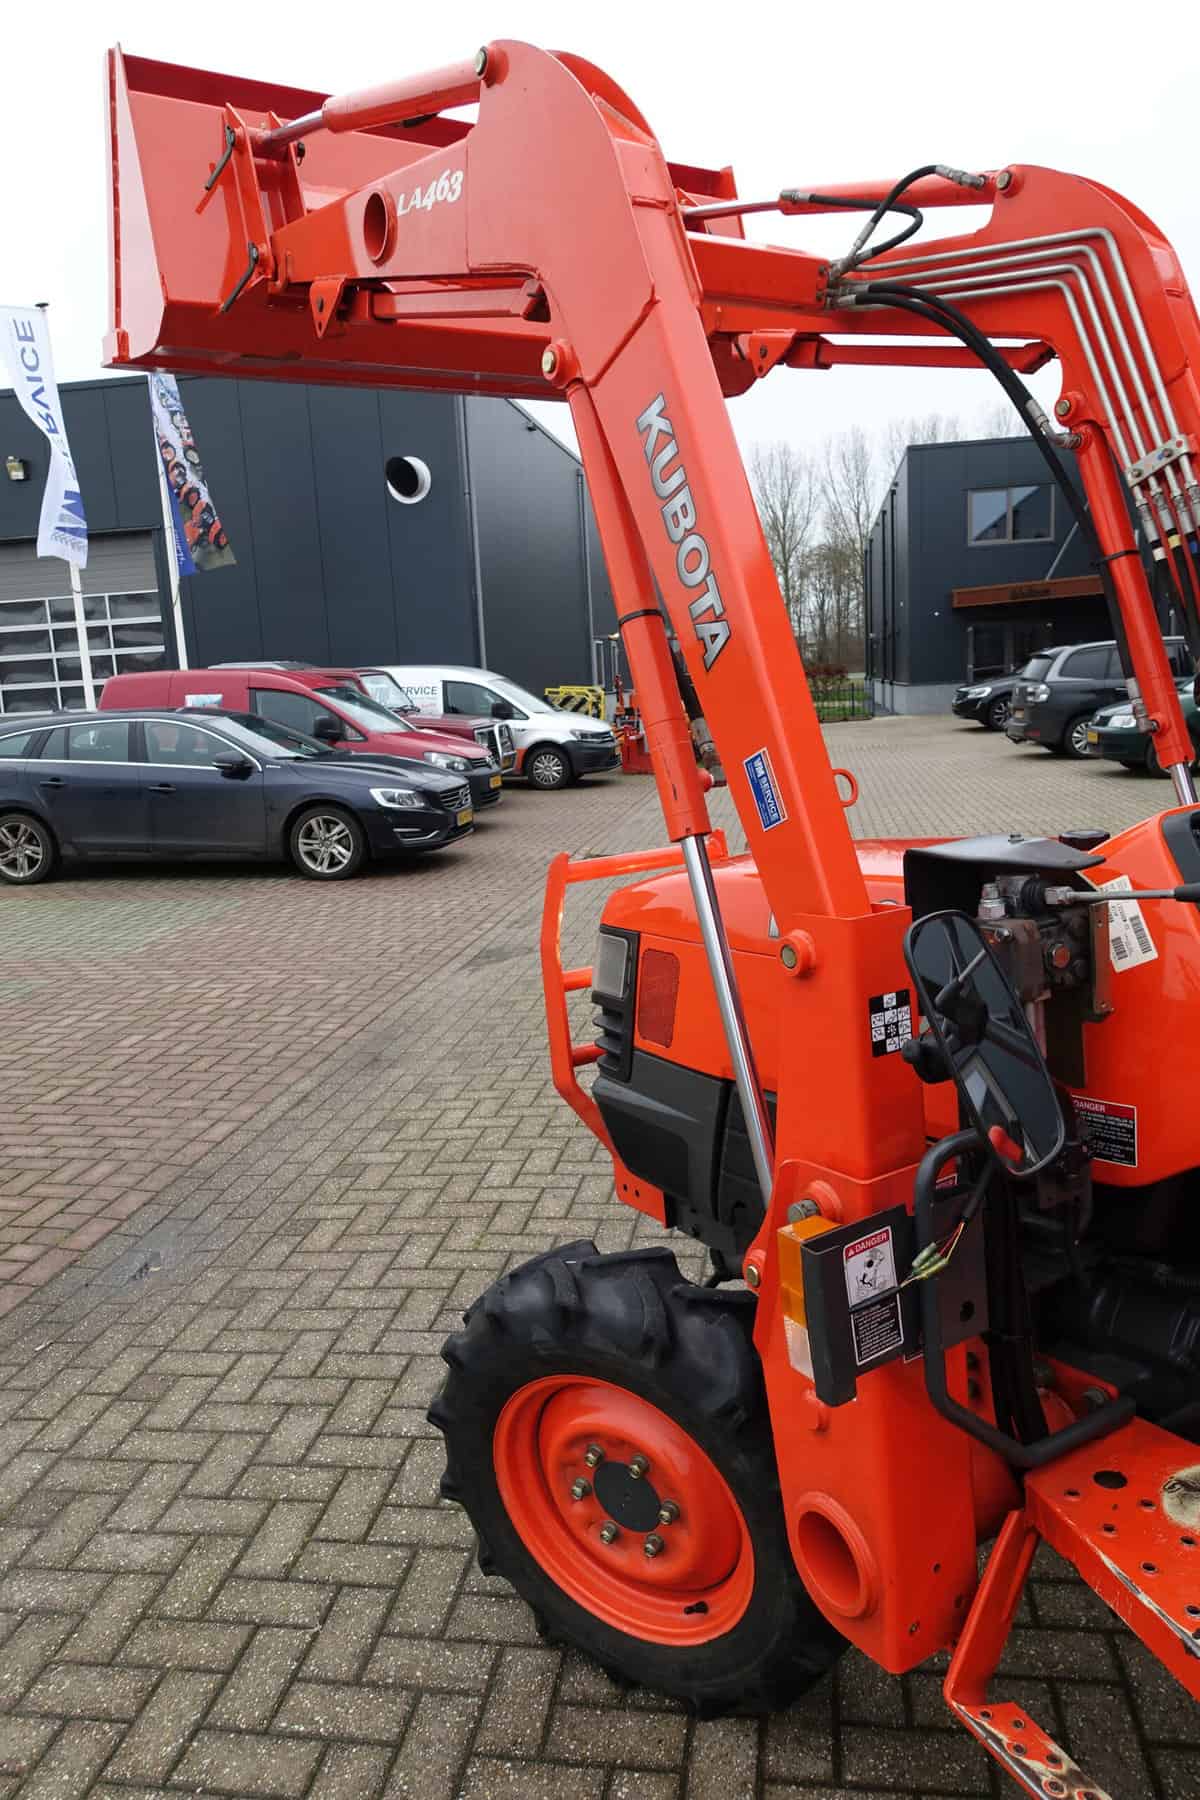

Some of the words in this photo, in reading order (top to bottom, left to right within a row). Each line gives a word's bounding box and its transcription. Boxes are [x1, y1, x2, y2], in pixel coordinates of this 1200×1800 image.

[397, 169, 464, 216] LA463
[636, 391, 731, 672] KUBOTA
[855, 1232, 887, 1252] DANGER
